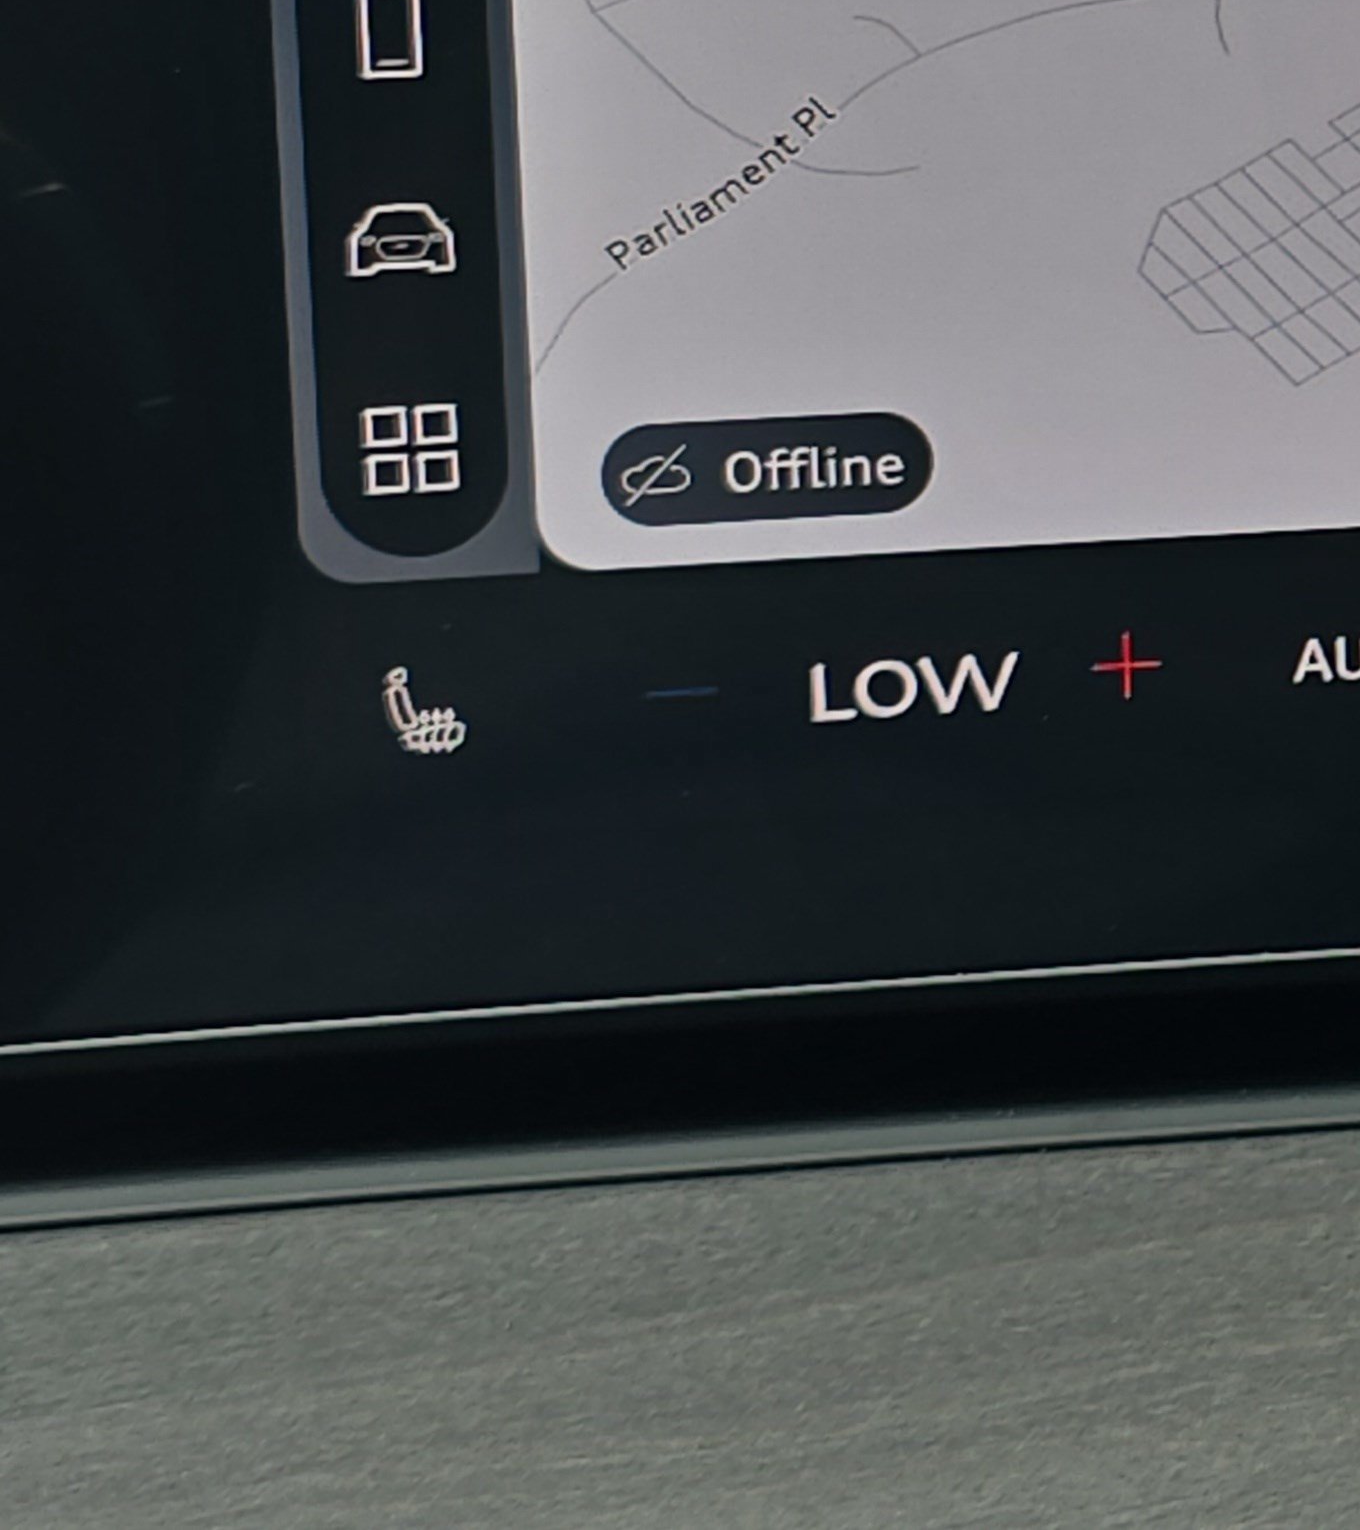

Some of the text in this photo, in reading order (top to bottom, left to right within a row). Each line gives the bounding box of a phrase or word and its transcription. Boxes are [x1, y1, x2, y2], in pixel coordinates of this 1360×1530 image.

[604, 96, 836, 270] Parliament Pl
[724, 447, 905, 493] Offline
[810, 651, 1020, 723] LOW
